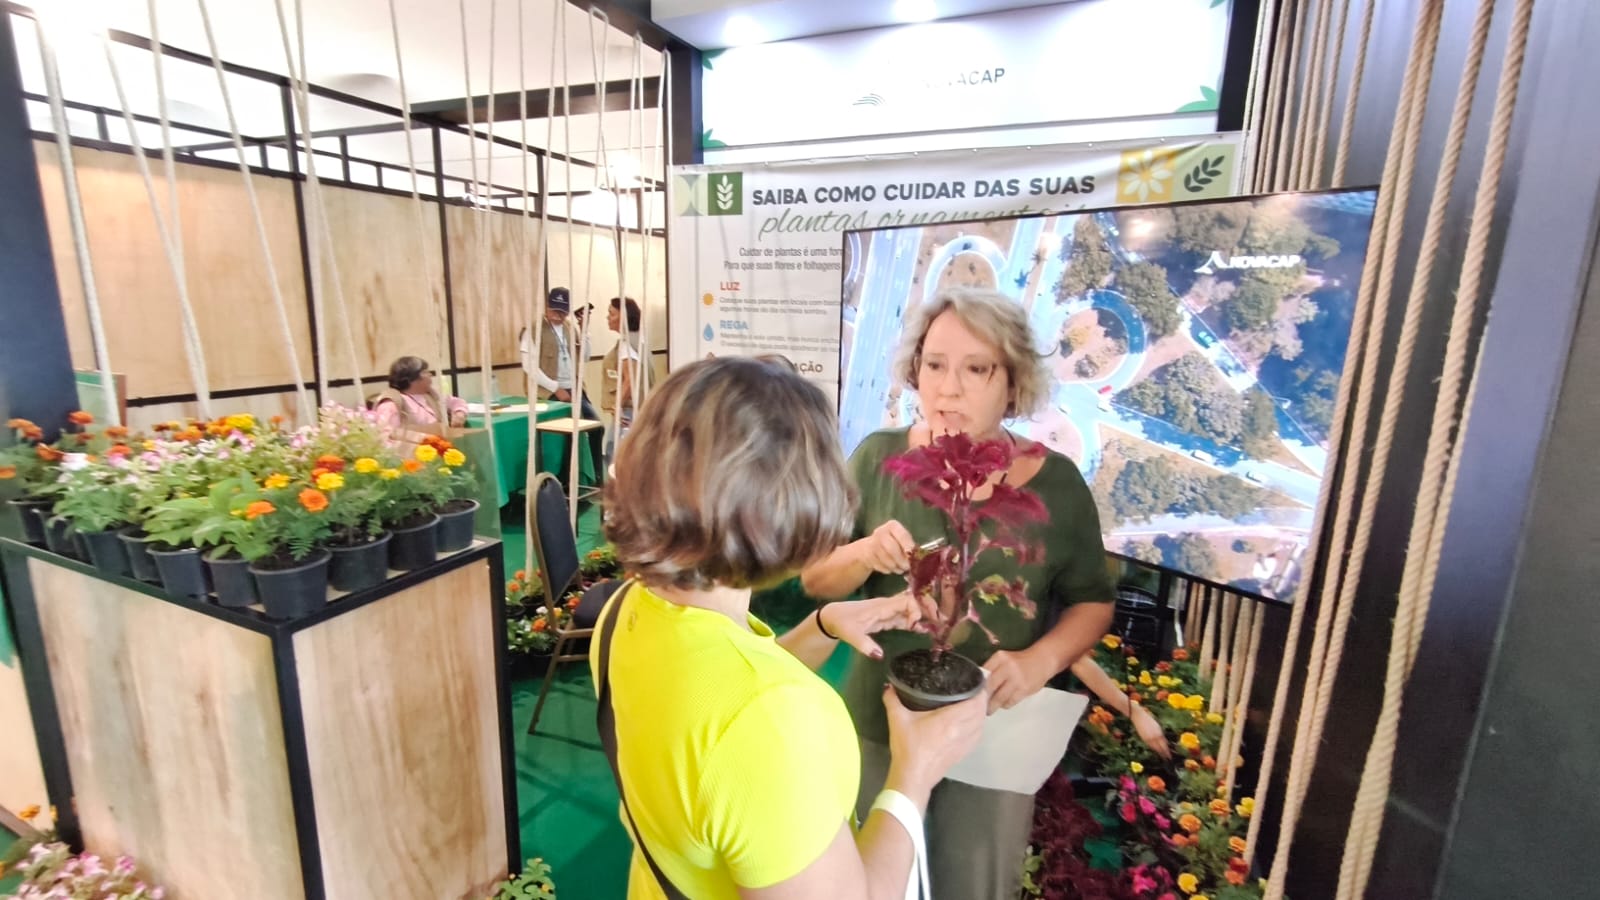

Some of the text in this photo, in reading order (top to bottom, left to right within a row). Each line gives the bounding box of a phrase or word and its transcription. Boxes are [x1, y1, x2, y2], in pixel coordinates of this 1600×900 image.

[752, 175, 1095, 205] SAIBA COMO CUIDAR DAS SUAS
[758, 207, 869, 241] plantas
[739, 247, 762, 256] Cuidar
[764, 247, 774, 256] de
[775, 247, 802, 258] plantas
[810, 248, 828, 256] uma
[724, 261, 740, 270] Para
[741, 262, 755, 271] que
[756, 262, 773, 270] suas
[775, 262, 795, 270] flores
[804, 262, 841, 271] folhagens
[1230, 255, 1301, 268] NOVACAP
[720, 281, 740, 291] LUZ
[720, 320, 749, 330] REGA
